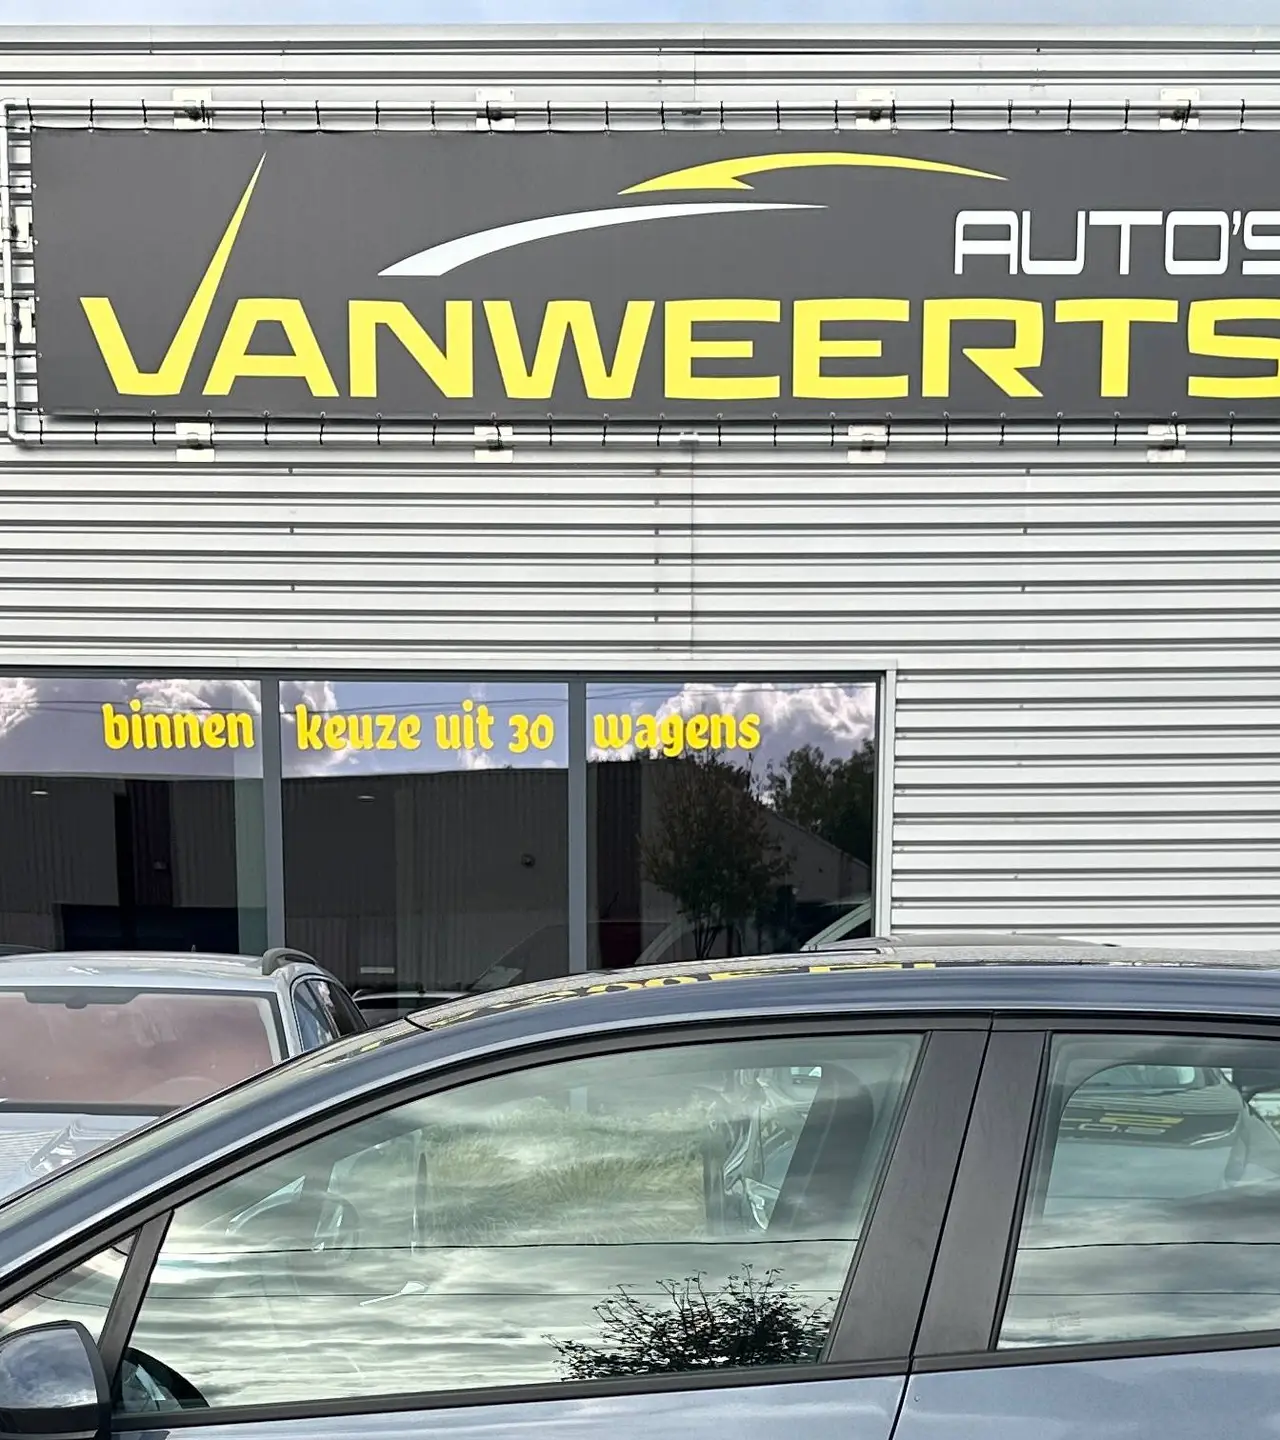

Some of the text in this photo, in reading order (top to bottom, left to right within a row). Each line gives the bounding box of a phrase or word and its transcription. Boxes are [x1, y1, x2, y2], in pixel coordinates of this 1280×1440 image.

[102, 702, 761, 758] binnen keuze uit 30 wagens
